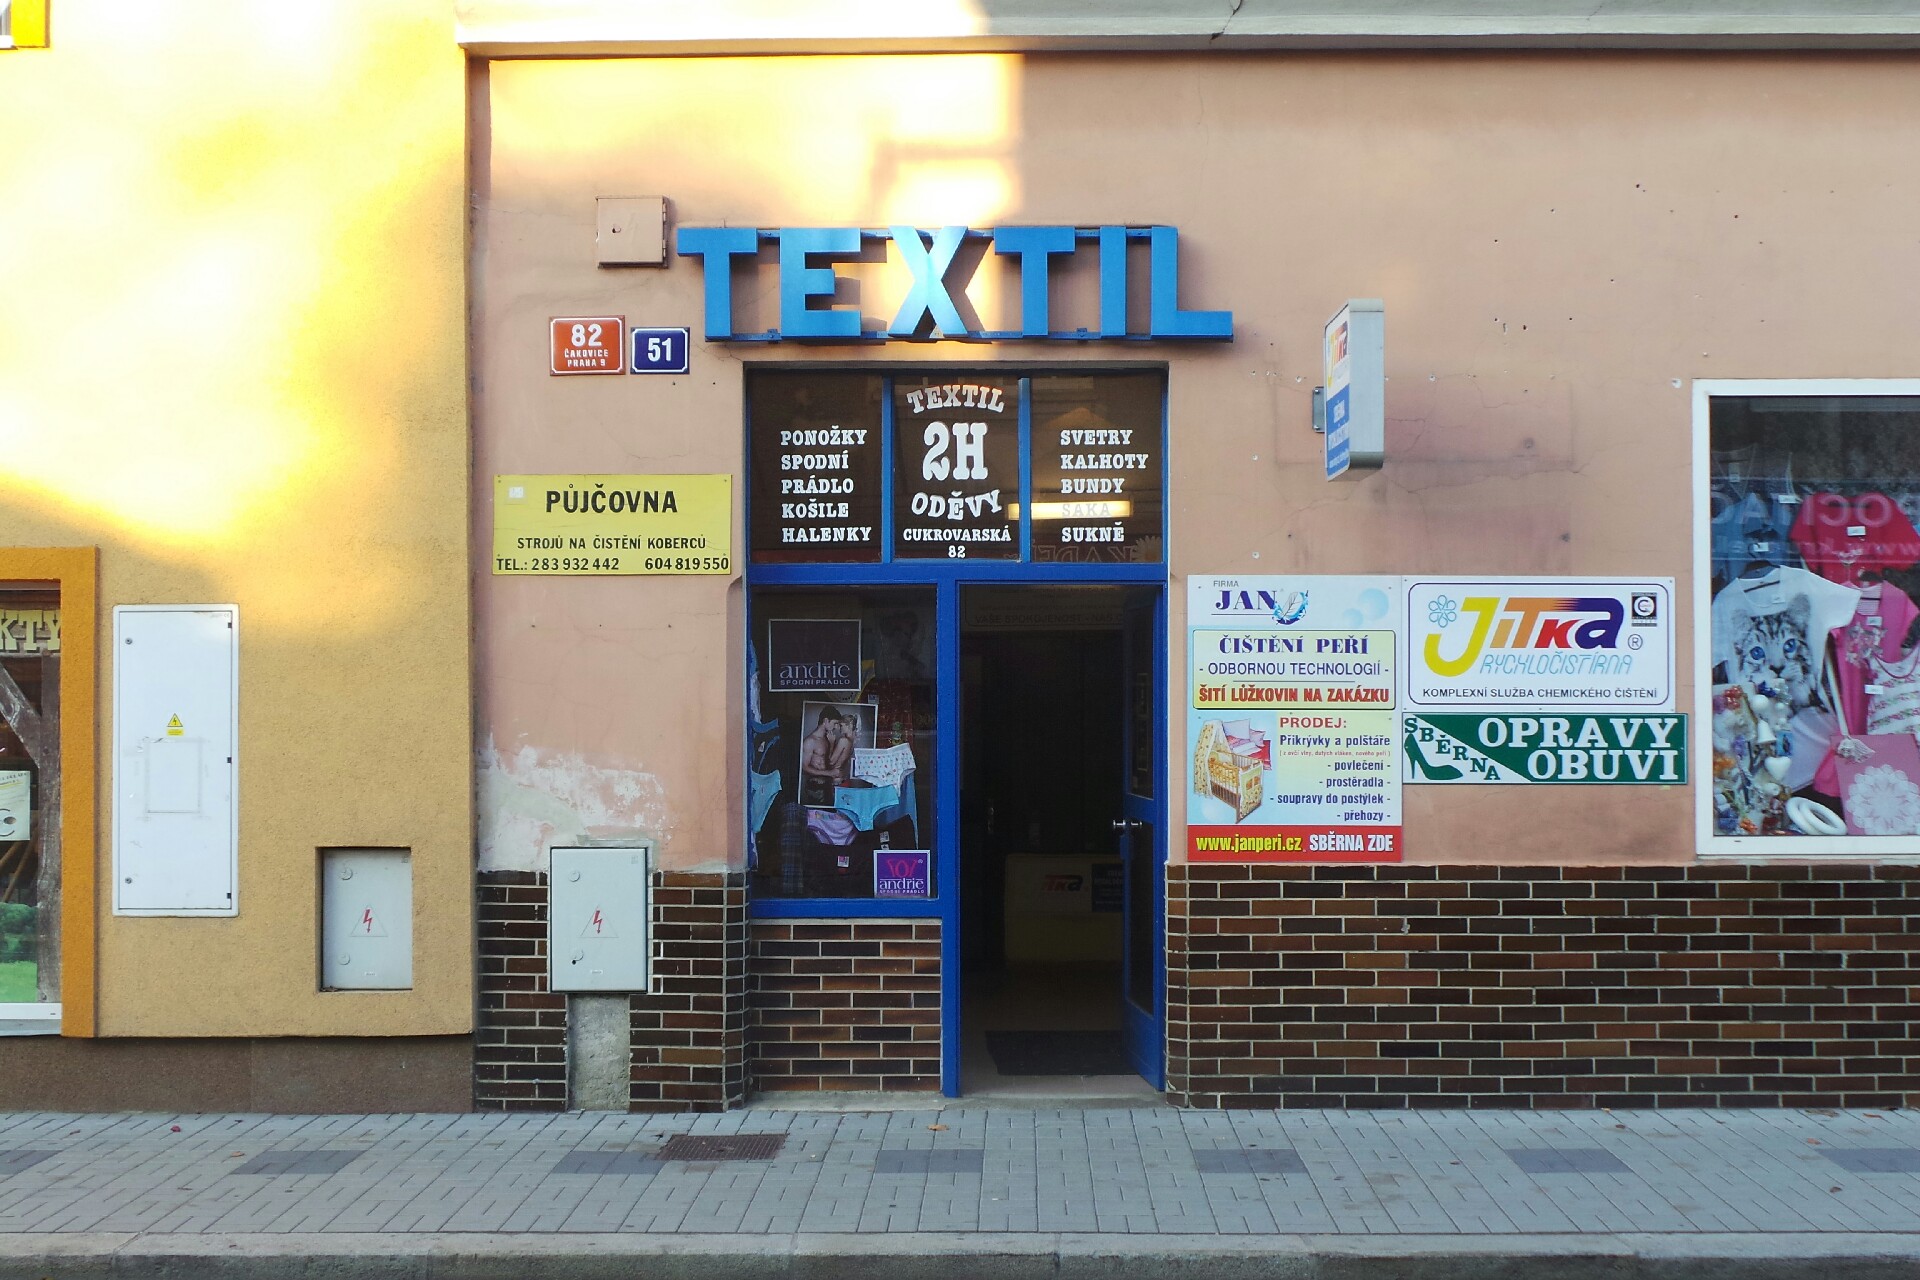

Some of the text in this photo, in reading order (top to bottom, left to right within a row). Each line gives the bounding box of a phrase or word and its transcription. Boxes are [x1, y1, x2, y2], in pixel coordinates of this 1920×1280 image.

[676, 225, 1234, 341] TEXTIL
[571, 323, 603, 347] 82
[564, 347, 609, 359] ČAKOVICE
[647, 338, 673, 362] 51
[567, 358, 607, 369] PRAHA 9
[906, 384, 1005, 414] TEXTIL
[780, 425, 868, 446] PONOŽKY
[1060, 429, 1133, 446] SVETRY
[780, 450, 849, 470] SPODNÍ
[921, 421, 989, 481] 2H
[1060, 454, 1149, 470] KALHOTY
[781, 474, 854, 495] PRÁDLO
[1060, 478, 1125, 494] BUNDY
[546, 483, 678, 513] PŮJČOVNA
[910, 488, 1004, 521] ODĚVY
[781, 498, 849, 519] KOŠILE
[1061, 503, 1112, 518] SAKA
[517, 534, 706, 549] STROJŮ NA ČISTĚNÍ KOBERCŮ
[781, 526, 872, 543] HALENKY
[903, 524, 1012, 542] CUKROVARSKÁ
[1061, 522, 1125, 543] SUKNĚ
[948, 545, 966, 559] 82
[496, 558, 527, 571] TEL.:
[1215, 590, 1277, 610] JAN
[1218, 634, 1369, 654] ČIŠTĚNÍ PEŘÍ
[1208, 662, 1285, 675] ODBORNOU
[1290, 660, 1381, 675] TECHNOLOGIÍ
[1198, 683, 1389, 702] ŠITÍ LŮŽKOVIN NA ZAKÁZKU
[1423, 686, 1657, 698] KOMPLEXNÍ SLUŽBA CHEMICKÉHO ČIŠTĚNÍ
[1280, 717, 1347, 729] PRODEJ:
[1477, 717, 1679, 748] OPRAVY
[1334, 737, 1342, 746] a
[1346, 734, 1390, 748] polštáře
[1404, 717, 1501, 780] SBĚRNA
[1527, 749, 1679, 780] OBUVI
[1326, 777, 1384, 788] prostěradla
[1277, 794, 1323, 805] soupravy
[1326, 793, 1338, 804] do
[1341, 793, 1384, 805] postýlek
[1344, 810, 1384, 822] přehozy
[1196, 830, 1394, 853] www.janperi.cz SBĚRNA ZDE
